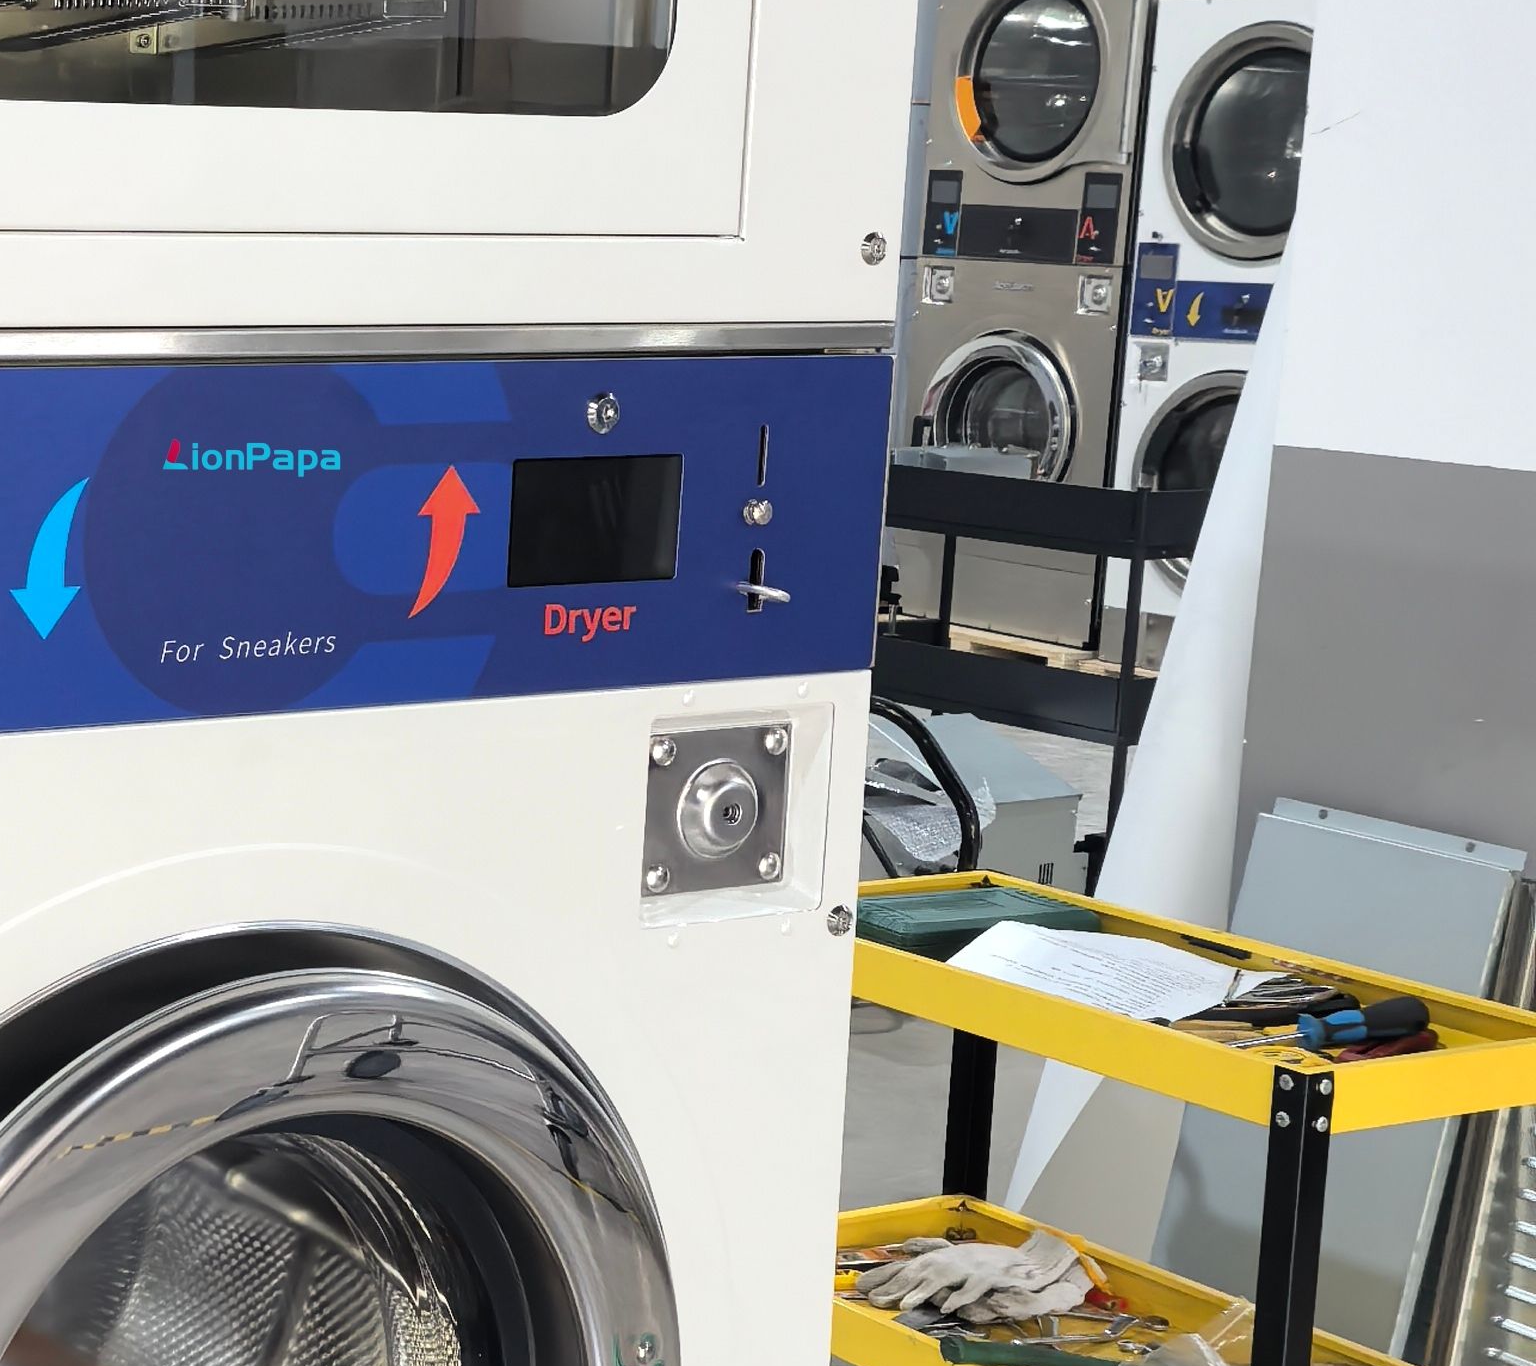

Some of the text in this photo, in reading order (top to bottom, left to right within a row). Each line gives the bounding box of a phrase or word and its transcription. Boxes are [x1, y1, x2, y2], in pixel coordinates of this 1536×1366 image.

[162, 438, 341, 477] LionPapa
[544, 603, 637, 643] Dryer
[160, 631, 336, 663] For Sneakers
